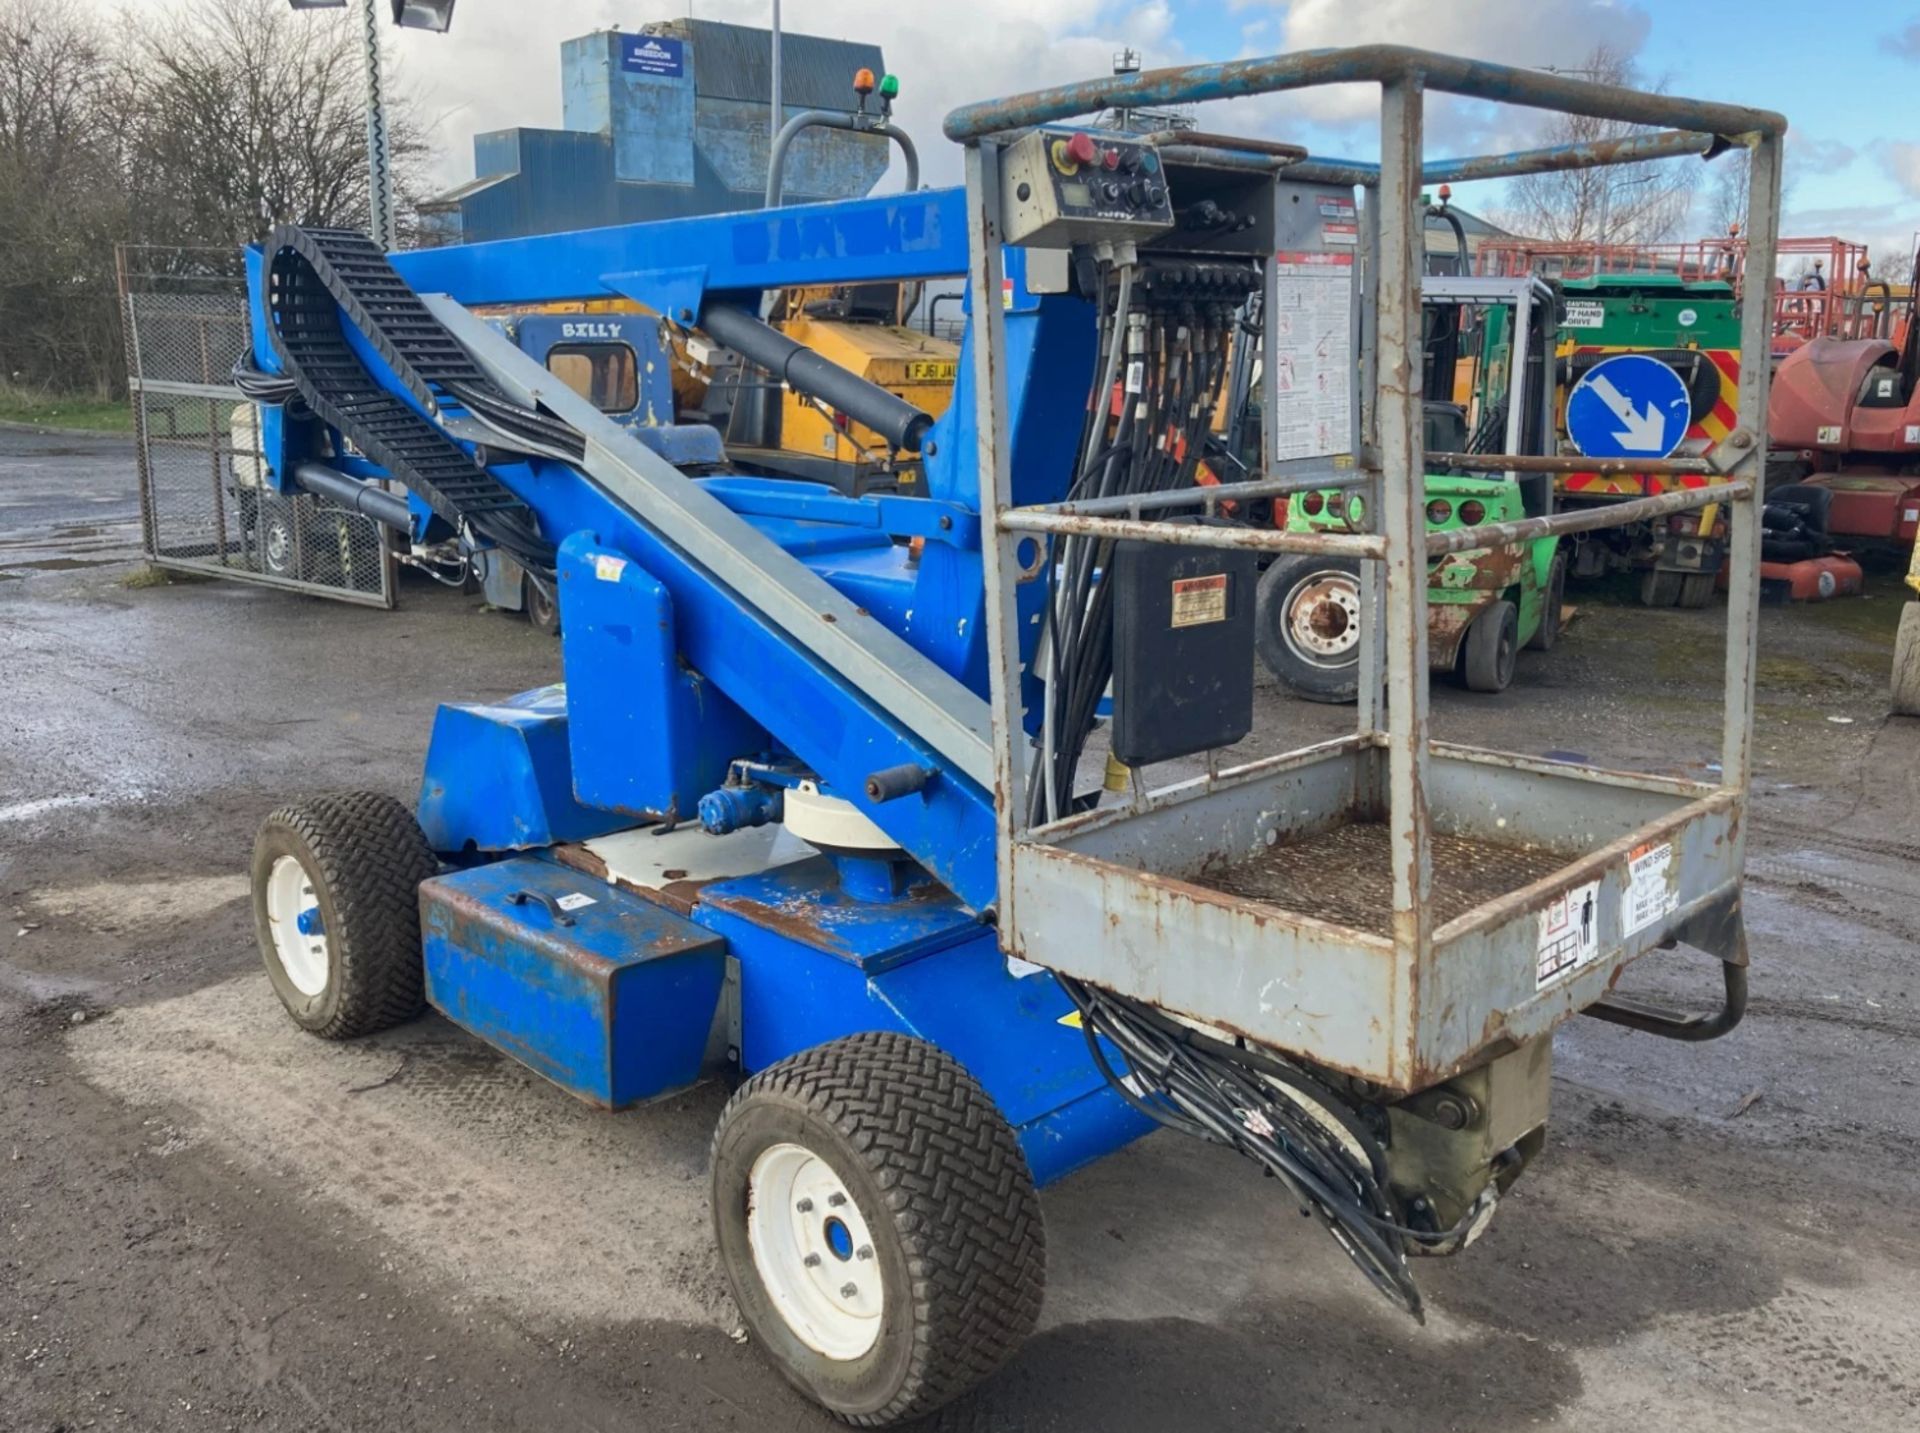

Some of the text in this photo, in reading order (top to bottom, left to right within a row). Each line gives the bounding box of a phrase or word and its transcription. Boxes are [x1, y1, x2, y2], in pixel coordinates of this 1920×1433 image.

[634, 48, 671, 60] BREEDON
[1578, 310, 1602, 318] HAND
[1567, 318, 1591, 326] DRIVE
[562, 323, 622, 338] BILLY
[1635, 855, 1652, 874] WIND
